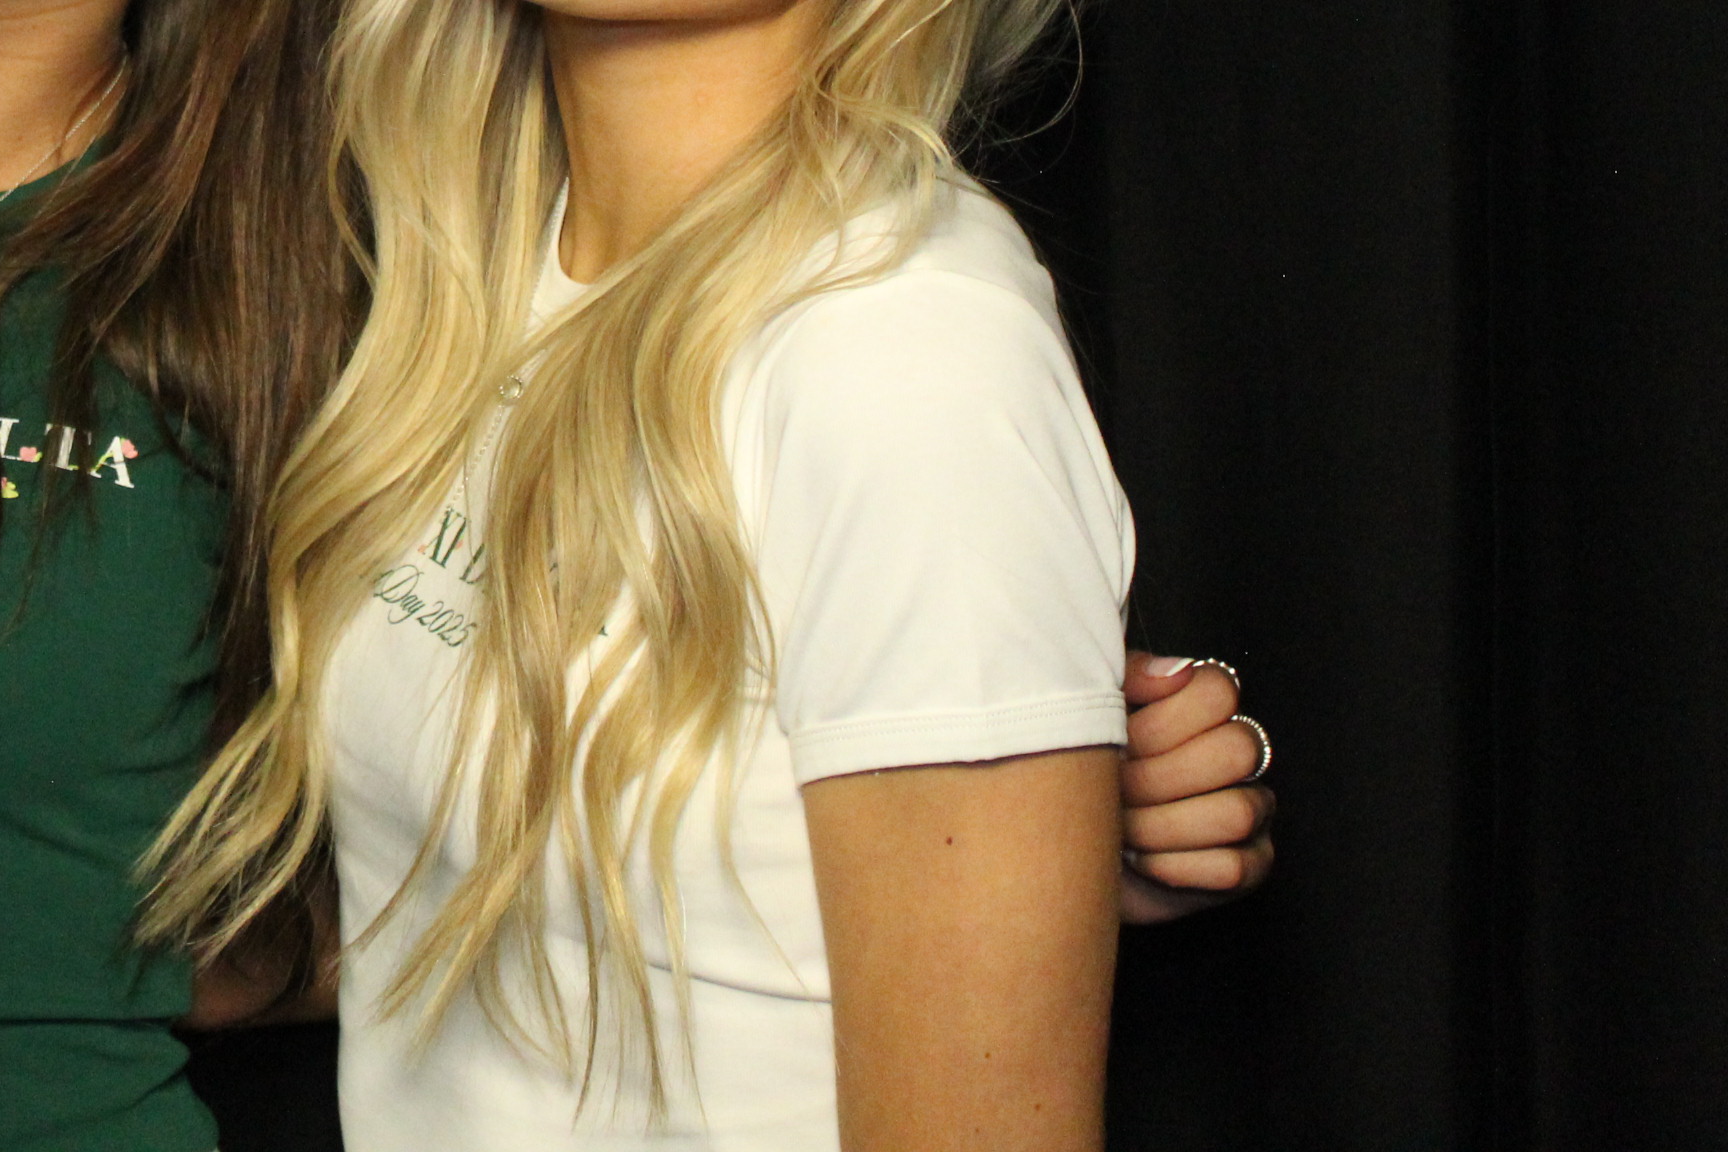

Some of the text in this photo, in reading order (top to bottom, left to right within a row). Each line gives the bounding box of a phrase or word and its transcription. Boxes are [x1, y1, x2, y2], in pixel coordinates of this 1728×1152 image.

[419, 508, 469, 569] XI
[373, 564, 425, 625] Day
[416, 600, 477, 647] 2025
